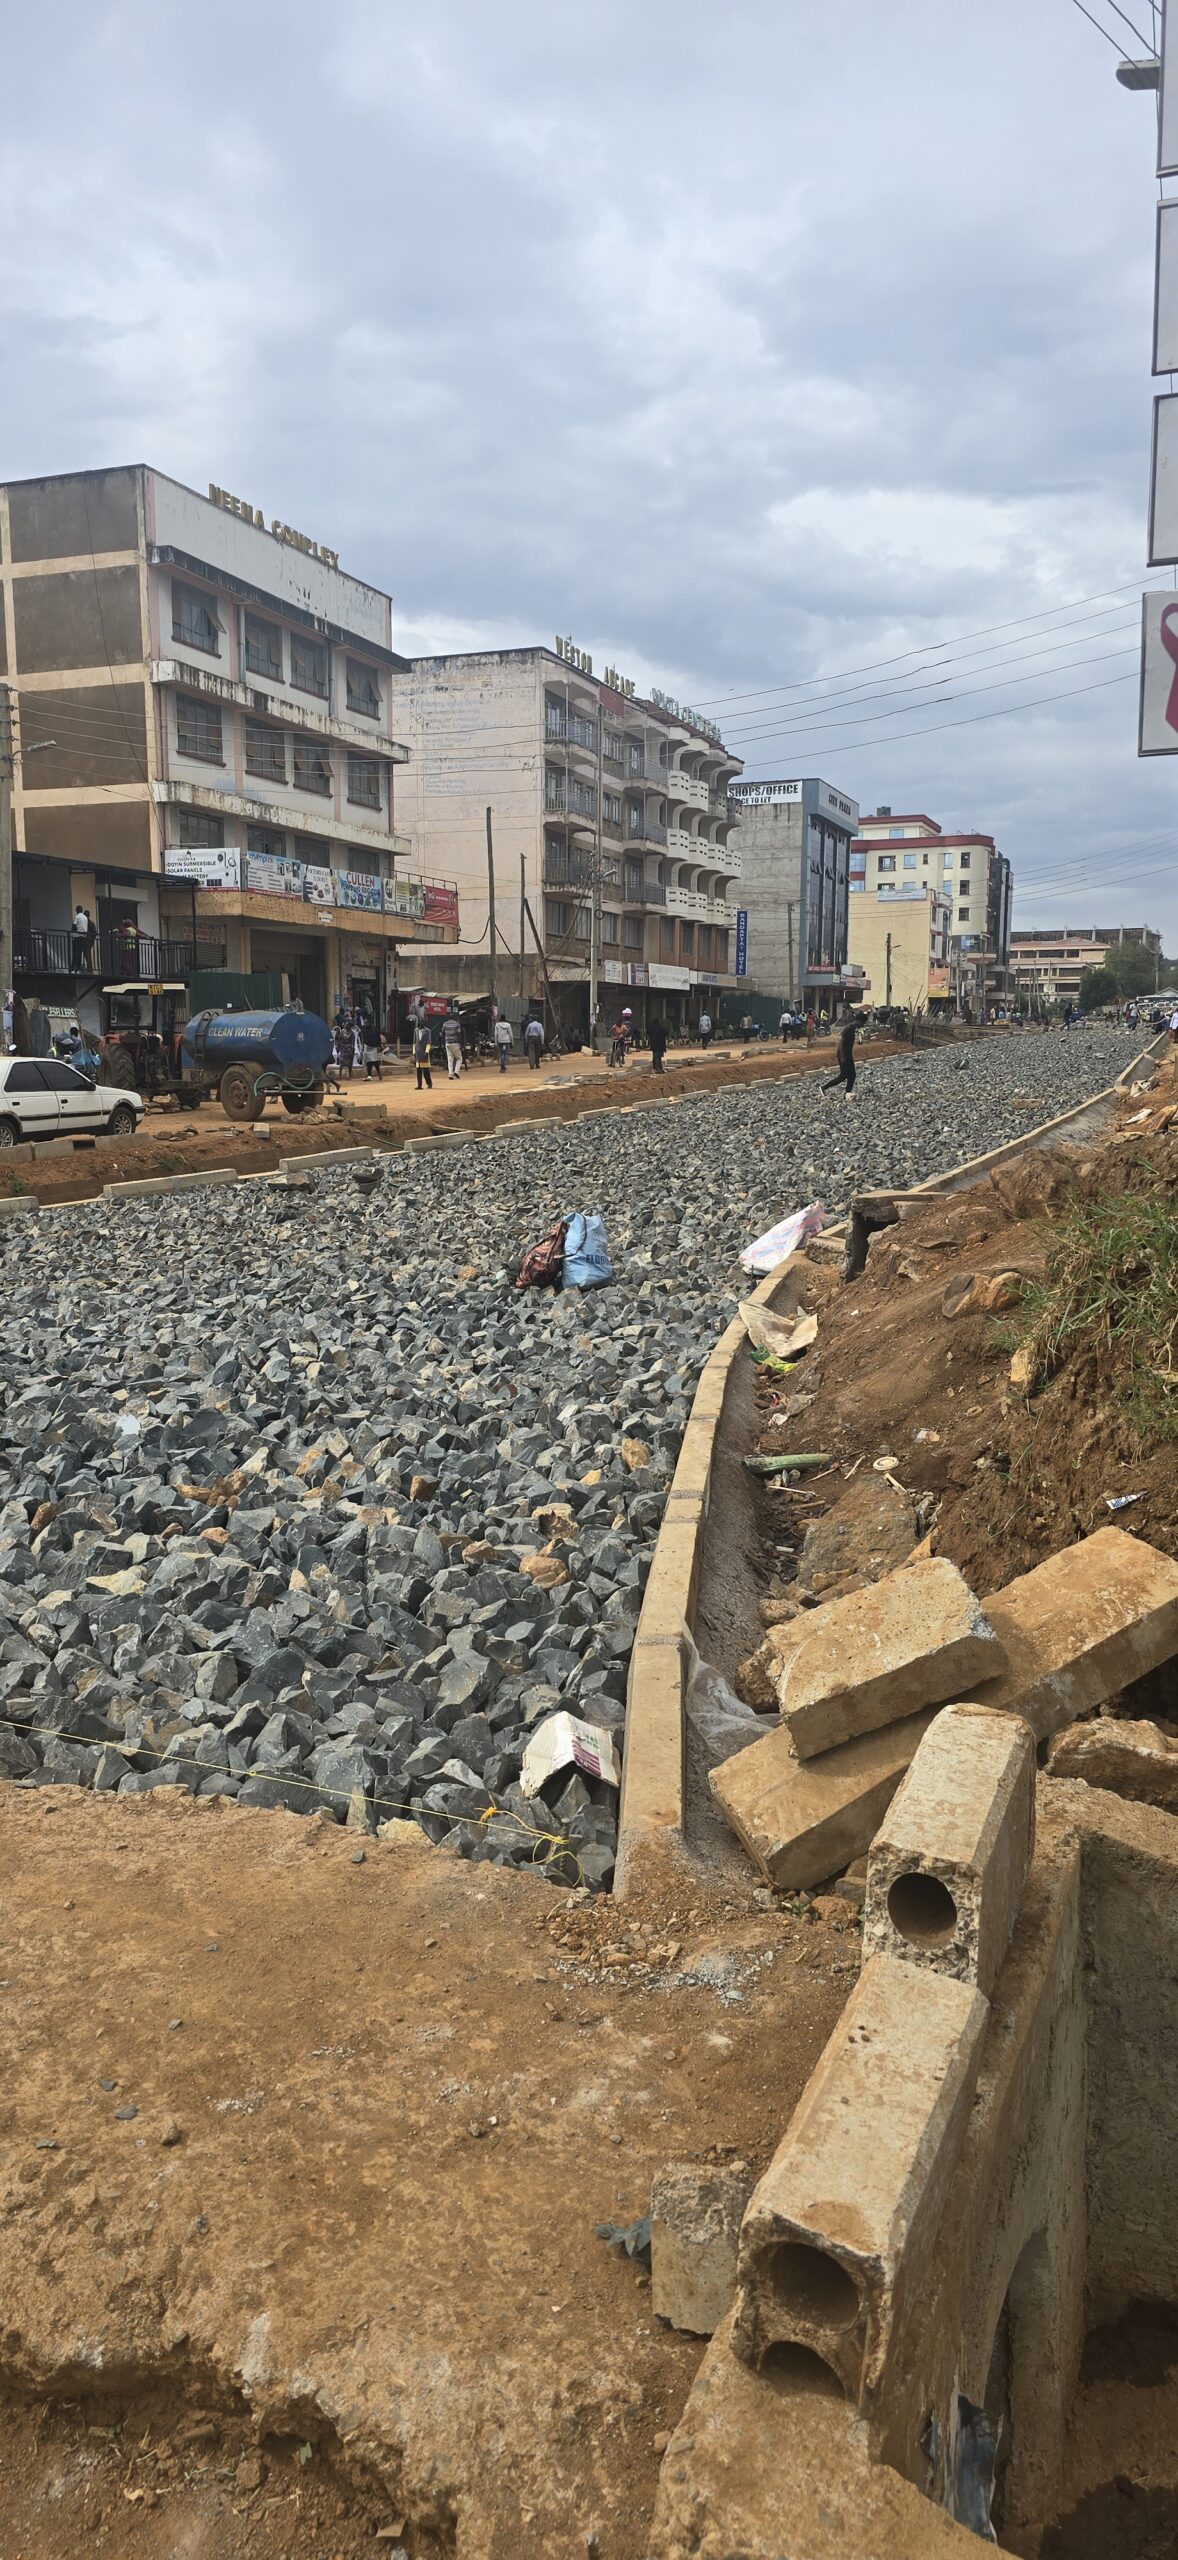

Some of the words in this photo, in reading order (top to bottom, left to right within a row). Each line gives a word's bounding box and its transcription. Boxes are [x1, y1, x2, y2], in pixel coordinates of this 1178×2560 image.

[208, 483, 265, 530] NEEMA
[271, 519, 339, 570] COMPLEX
[728, 784, 799, 798] SHOPS/OFFICE
[760, 796, 772, 804] LET
[346, 872, 375, 887] CULLEN
[208, 1026, 234, 1037] CLEAN
[235, 1026, 264, 1038] WATER
